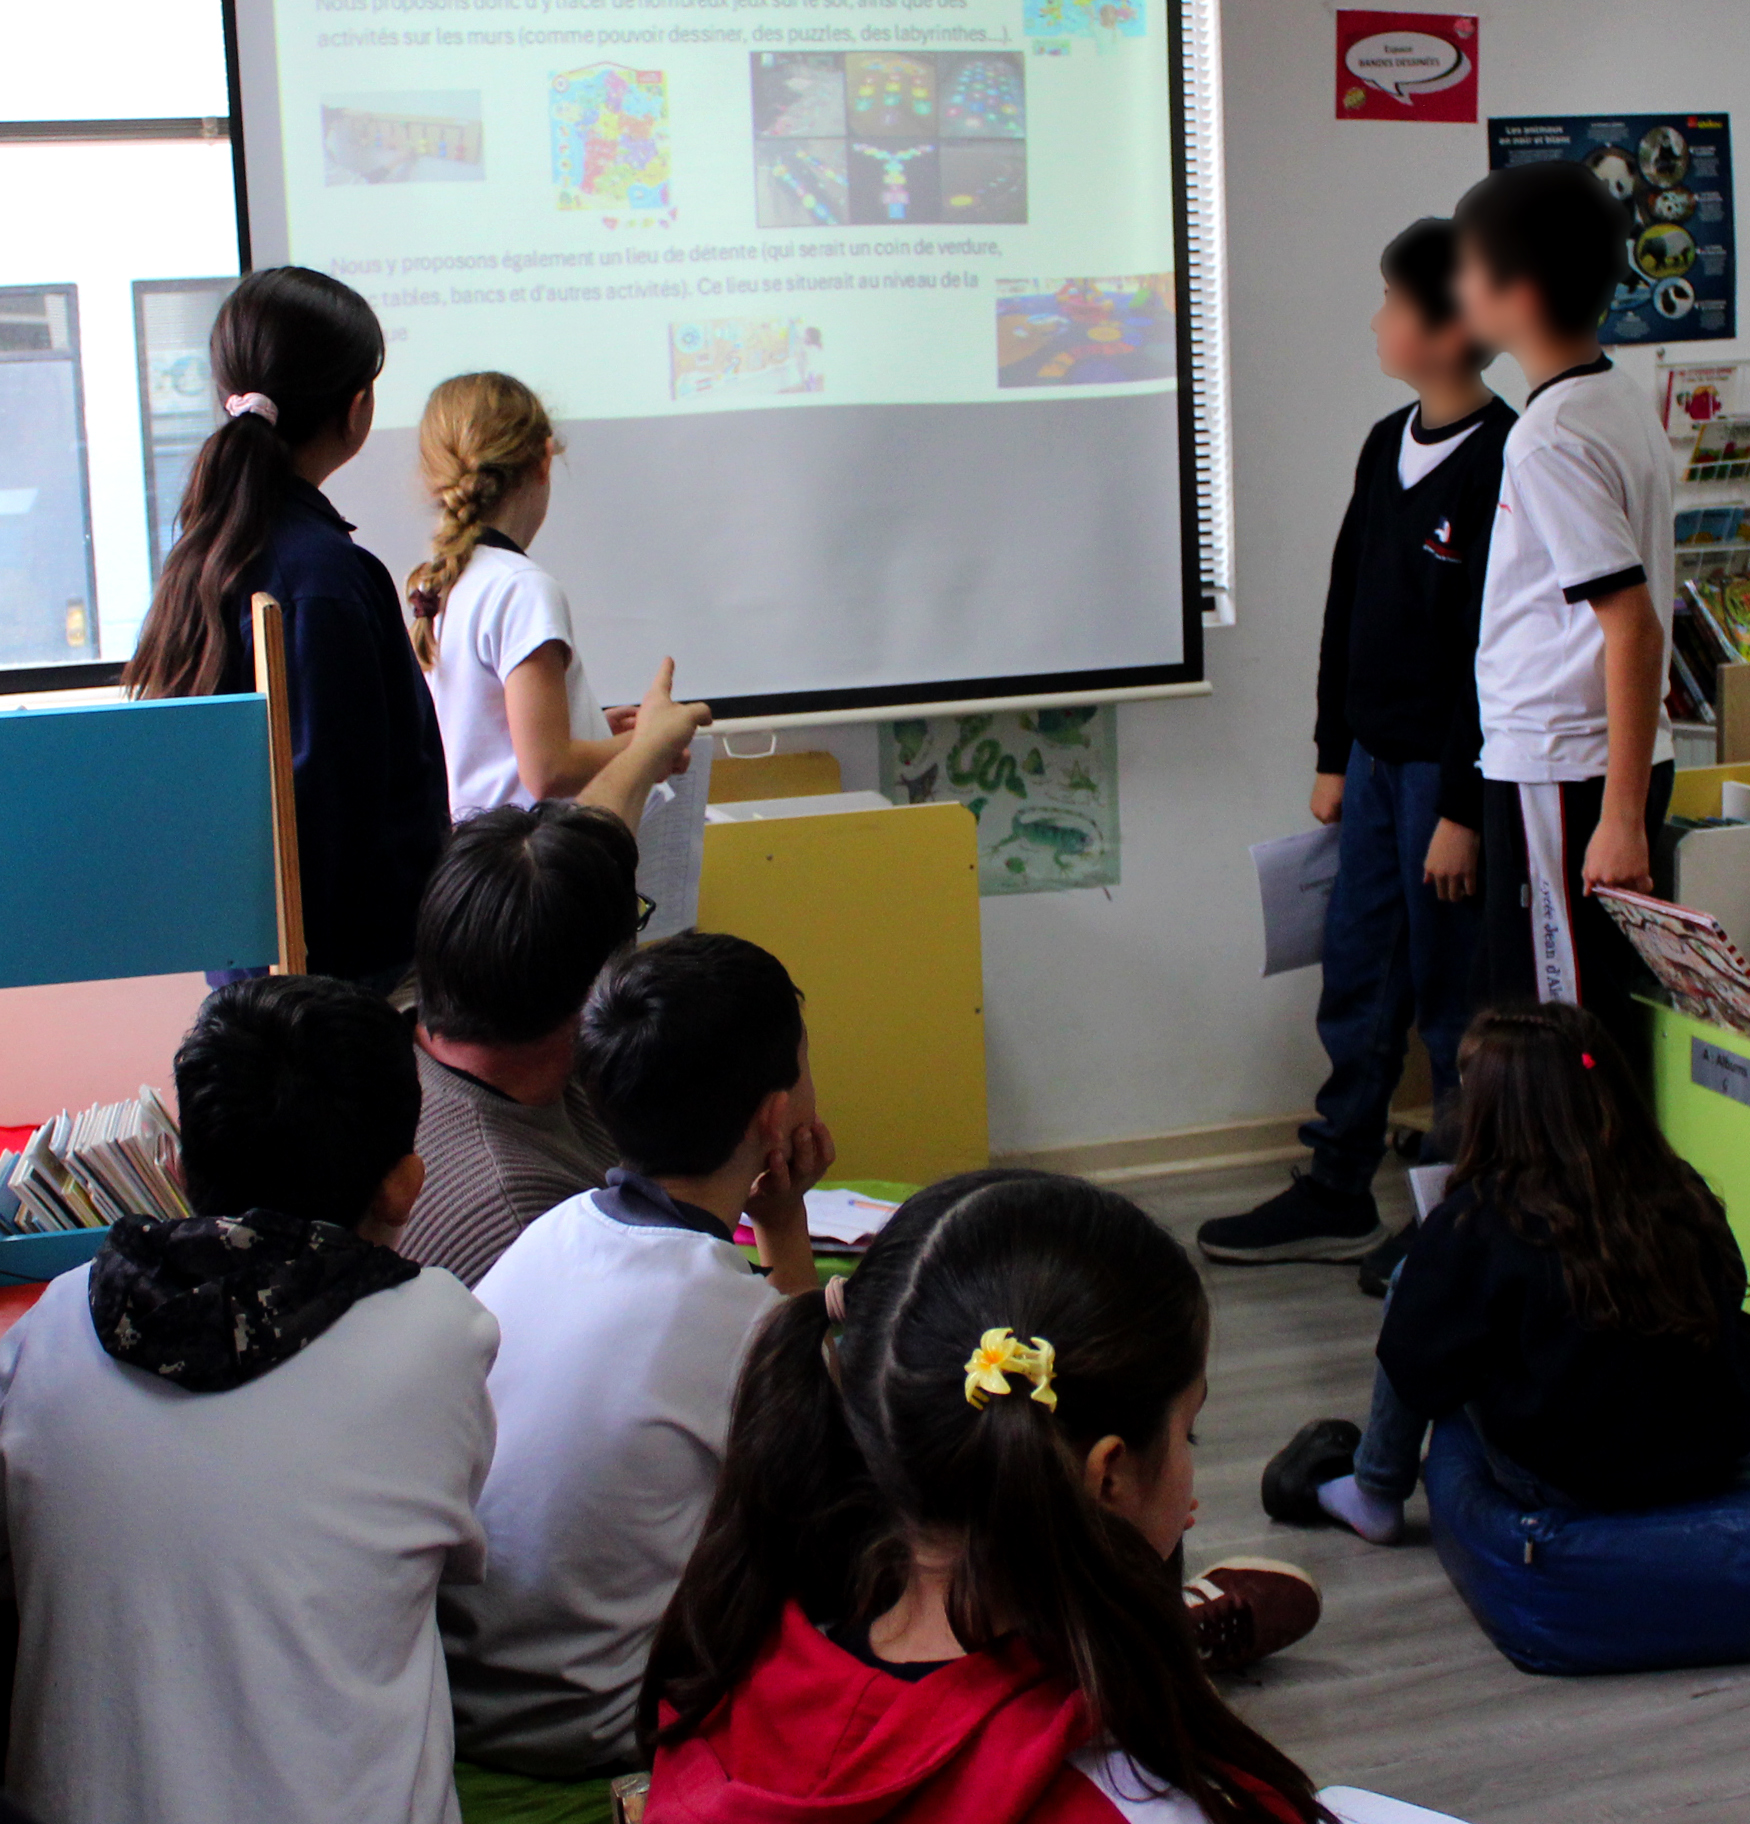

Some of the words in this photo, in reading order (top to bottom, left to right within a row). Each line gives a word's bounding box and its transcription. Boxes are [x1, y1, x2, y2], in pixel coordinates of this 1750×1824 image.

[316, 27, 399, 48] activités
[402, 31, 431, 45] sur
[436, 26, 464, 45] les
[466, 30, 514, 45] murs
[517, 25, 593, 47] (comme
[598, 26, 665, 47] pouvoir
[668, 25, 748, 44] dessiner,
[752, 25, 783, 43] des
[787, 24, 855, 45] puzzles,
[860, 24, 891, 42] des
[330, 256, 381, 275] Nous
[385, 258, 398, 276] y
[401, 253, 498, 274] proposons
[501, 250, 595, 272] également
[599, 251, 622, 266] un
[625, 247, 659, 265] lieu
[662, 245, 685, 263] de
[689, 244, 758, 263] détente
[762, 242, 795, 263] (qui
[799, 240, 846, 257] serait
[849, 242, 871, 256] un
[874, 238, 911, 256] coin
[914, 238, 935, 256] de
[938, 238, 1003, 258] verdure,
[382, 286, 447, 307] tables,
[450, 285, 505, 304] bancs
[510, 286, 527, 302] et
[530, 284, 601, 303] d'autres
[696, 277, 723, 296] Ce
[726, 276, 759, 295] lieu
[762, 278, 782, 293] se
[785, 273, 854, 292] situerait
[858, 275, 880, 289] au
[883, 271, 937, 289] niveau
[940, 270, 961, 288] de
[963, 270, 980, 288] la
[1544, 923, 1559, 959] Jean
